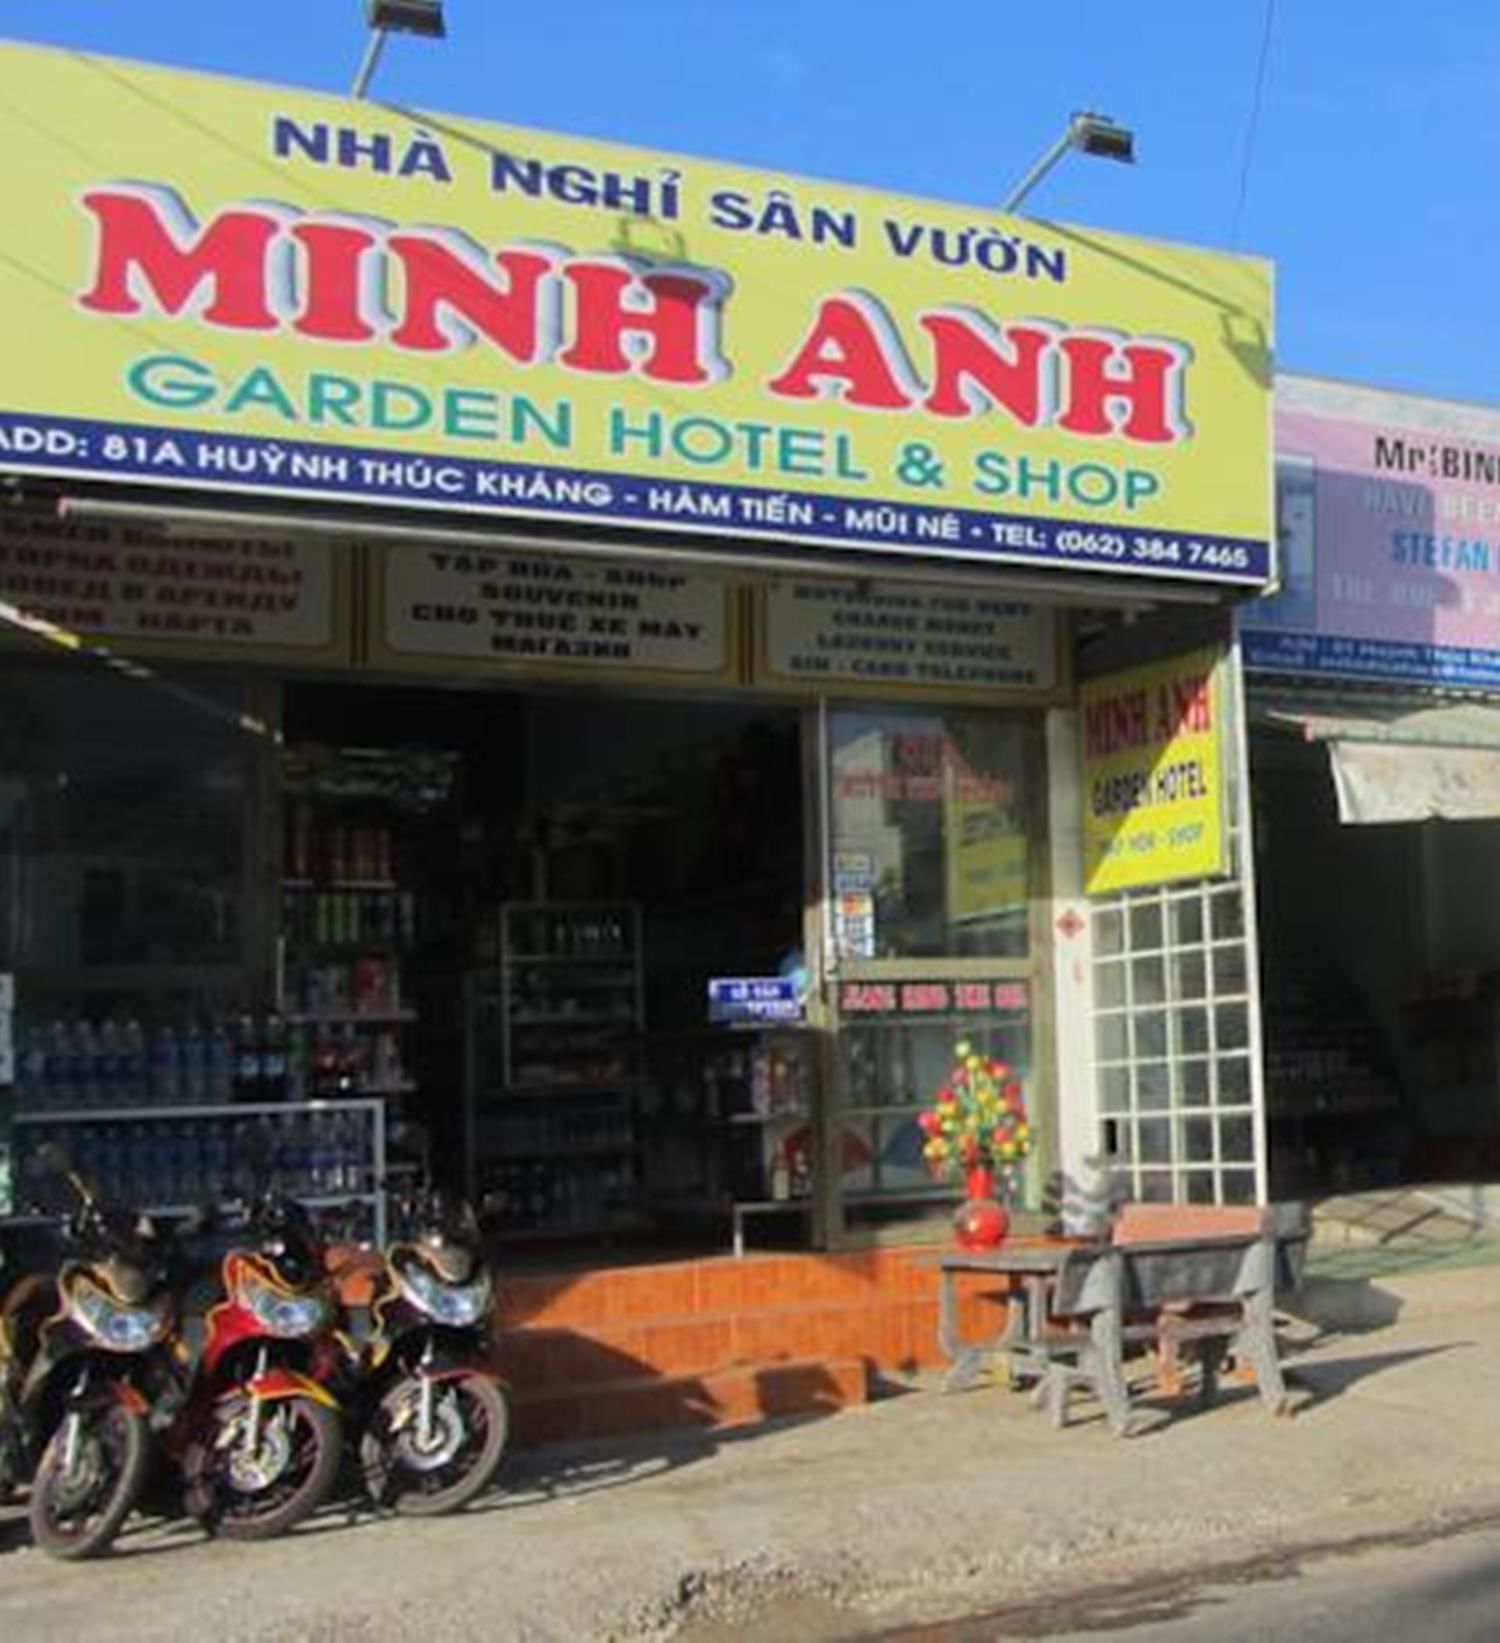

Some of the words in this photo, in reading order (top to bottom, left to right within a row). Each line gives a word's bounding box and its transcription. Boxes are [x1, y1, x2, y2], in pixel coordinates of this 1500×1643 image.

[273, 117, 452, 183] NHÀ
[711, 189, 855, 249] SÂN
[79, 186, 722, 386] MINH
[768, 292, 1185, 442] ANH
[126, 355, 573, 449] GARDEN
[609, 408, 868, 481] HOTEL
[896, 443, 945, 490] &
[974, 452, 1160, 509] SHOP
[102, 434, 185, 466] 81A
[361, 455, 465, 492] THÚC
[991, 522, 1047, 550] TEL:
[1055, 528, 1125, 557] (062)
[1133, 537, 1180, 563] 384
[1186, 541, 1248, 569] 7465
[1391, 532, 1489, 573] STEFAN
